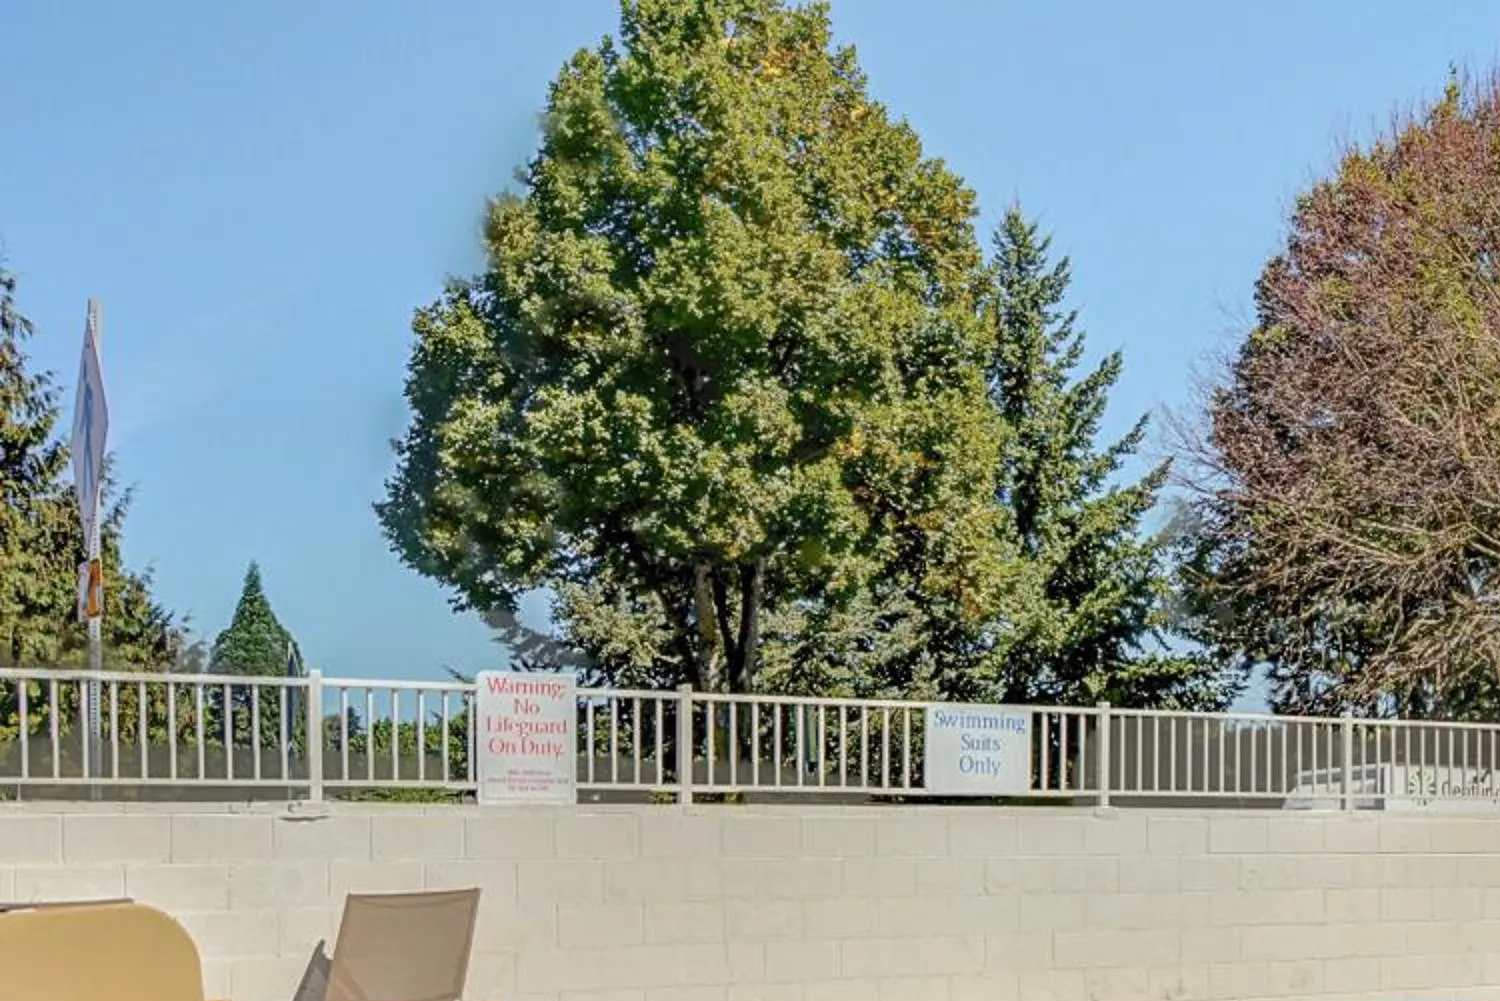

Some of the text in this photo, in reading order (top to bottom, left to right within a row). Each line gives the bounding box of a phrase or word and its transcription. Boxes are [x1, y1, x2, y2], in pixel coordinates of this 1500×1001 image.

[513, 699, 541, 715] No
[487, 716, 567, 737] Lifeguard
[933, 710, 1025, 735] Swimming
[488, 738, 516, 755] On
[960, 734, 1001, 751] Suits
[960, 755, 1001, 777] Only
